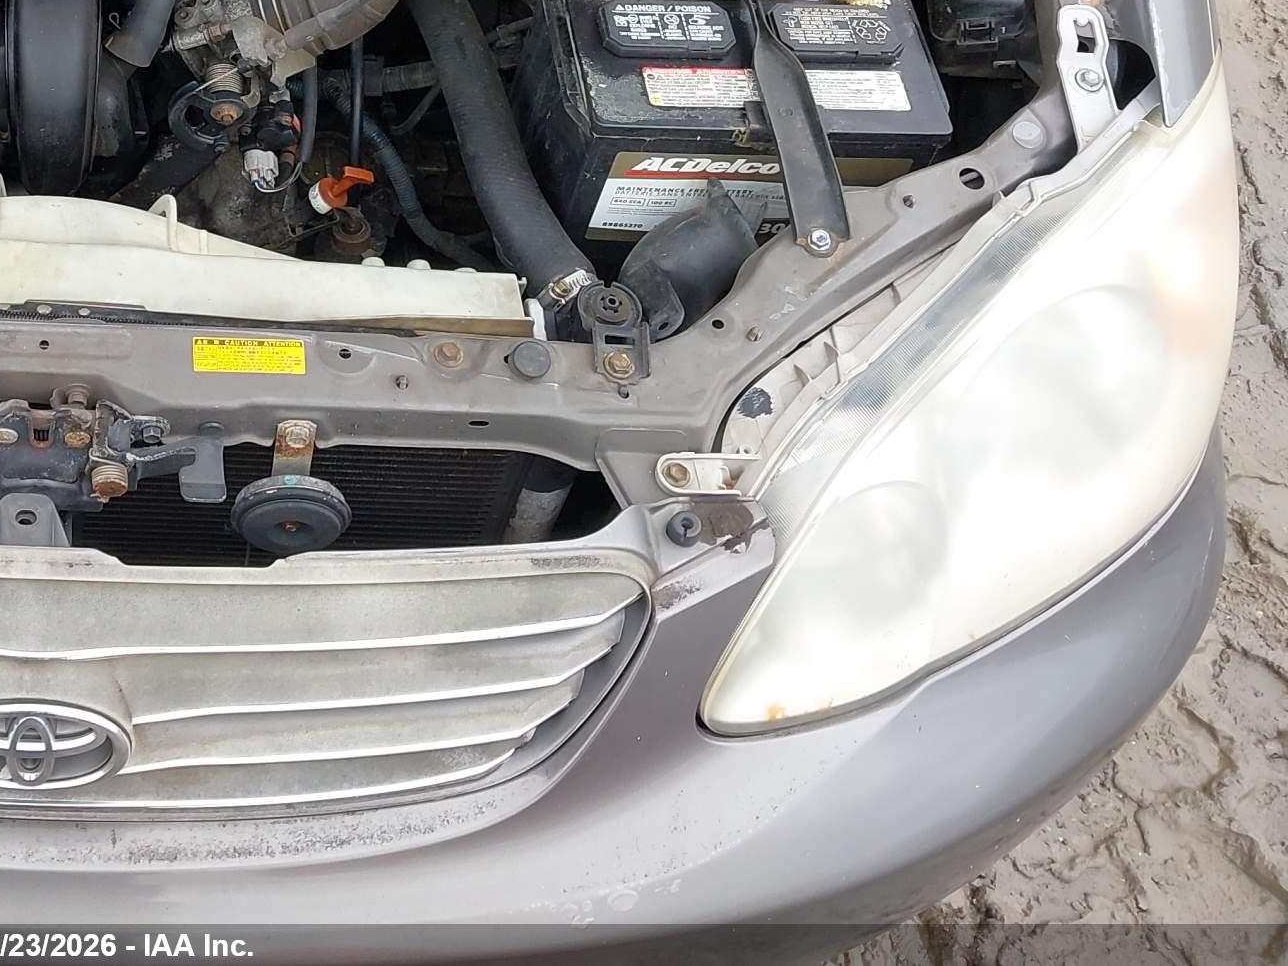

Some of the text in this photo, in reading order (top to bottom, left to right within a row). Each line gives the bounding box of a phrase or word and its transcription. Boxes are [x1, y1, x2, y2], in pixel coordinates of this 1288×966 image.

[624, 4, 665, 12] DANGER
[675, 5, 712, 13] POISON
[631, 157, 781, 174] ACDelco
[616, 185, 685, 195] MAINTENANCE
